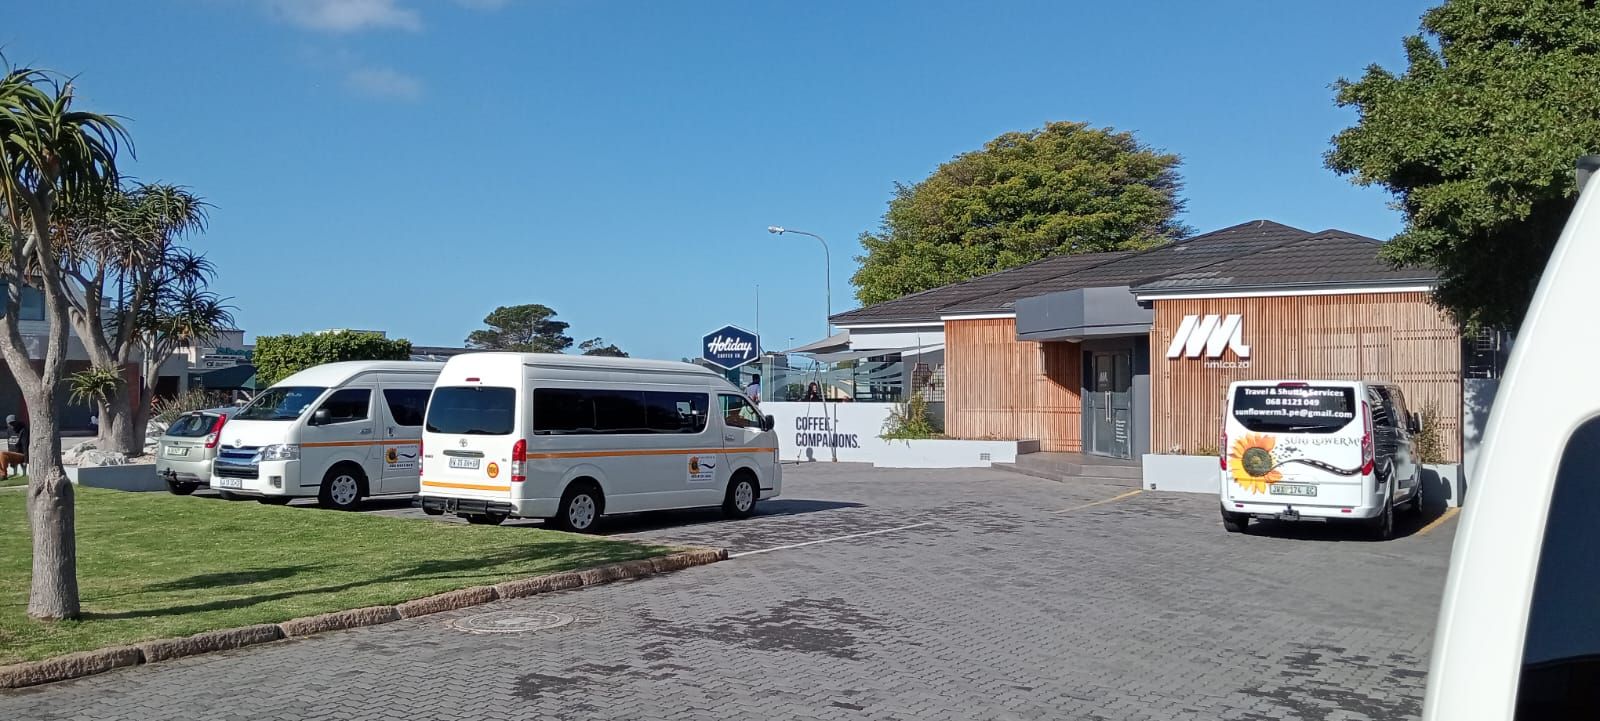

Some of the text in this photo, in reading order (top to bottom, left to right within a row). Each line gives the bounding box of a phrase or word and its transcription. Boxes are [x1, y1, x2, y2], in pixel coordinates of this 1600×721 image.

[1244, 388, 1345, 398] Travel & Shuttle Services
[1282, 398, 1302, 406] 8121
[1303, 398, 1320, 406] 049
[1235, 407, 1353, 418] sunflowerm3.pe@gmail.com
